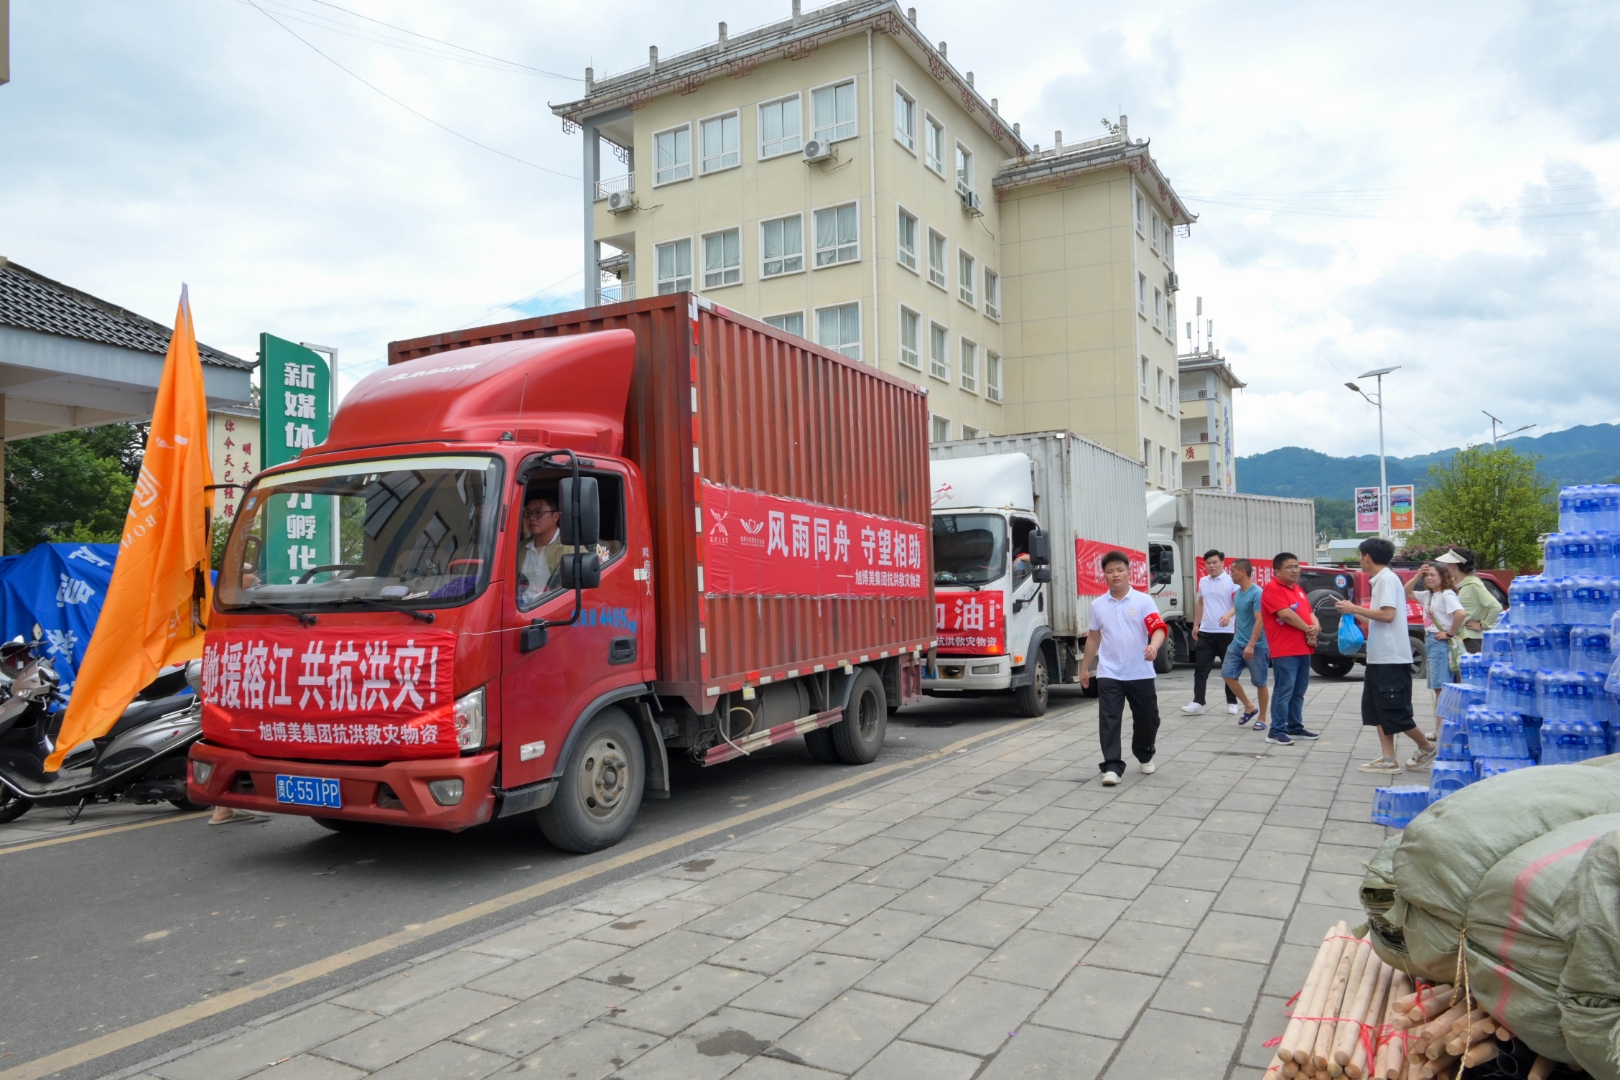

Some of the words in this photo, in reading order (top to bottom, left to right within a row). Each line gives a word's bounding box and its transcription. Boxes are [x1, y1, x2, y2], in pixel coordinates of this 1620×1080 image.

[767, 510, 850, 562] 风雨同舟
[861, 525, 920, 569] 守望相助
[201, 640, 293, 710] 驰援榕江
